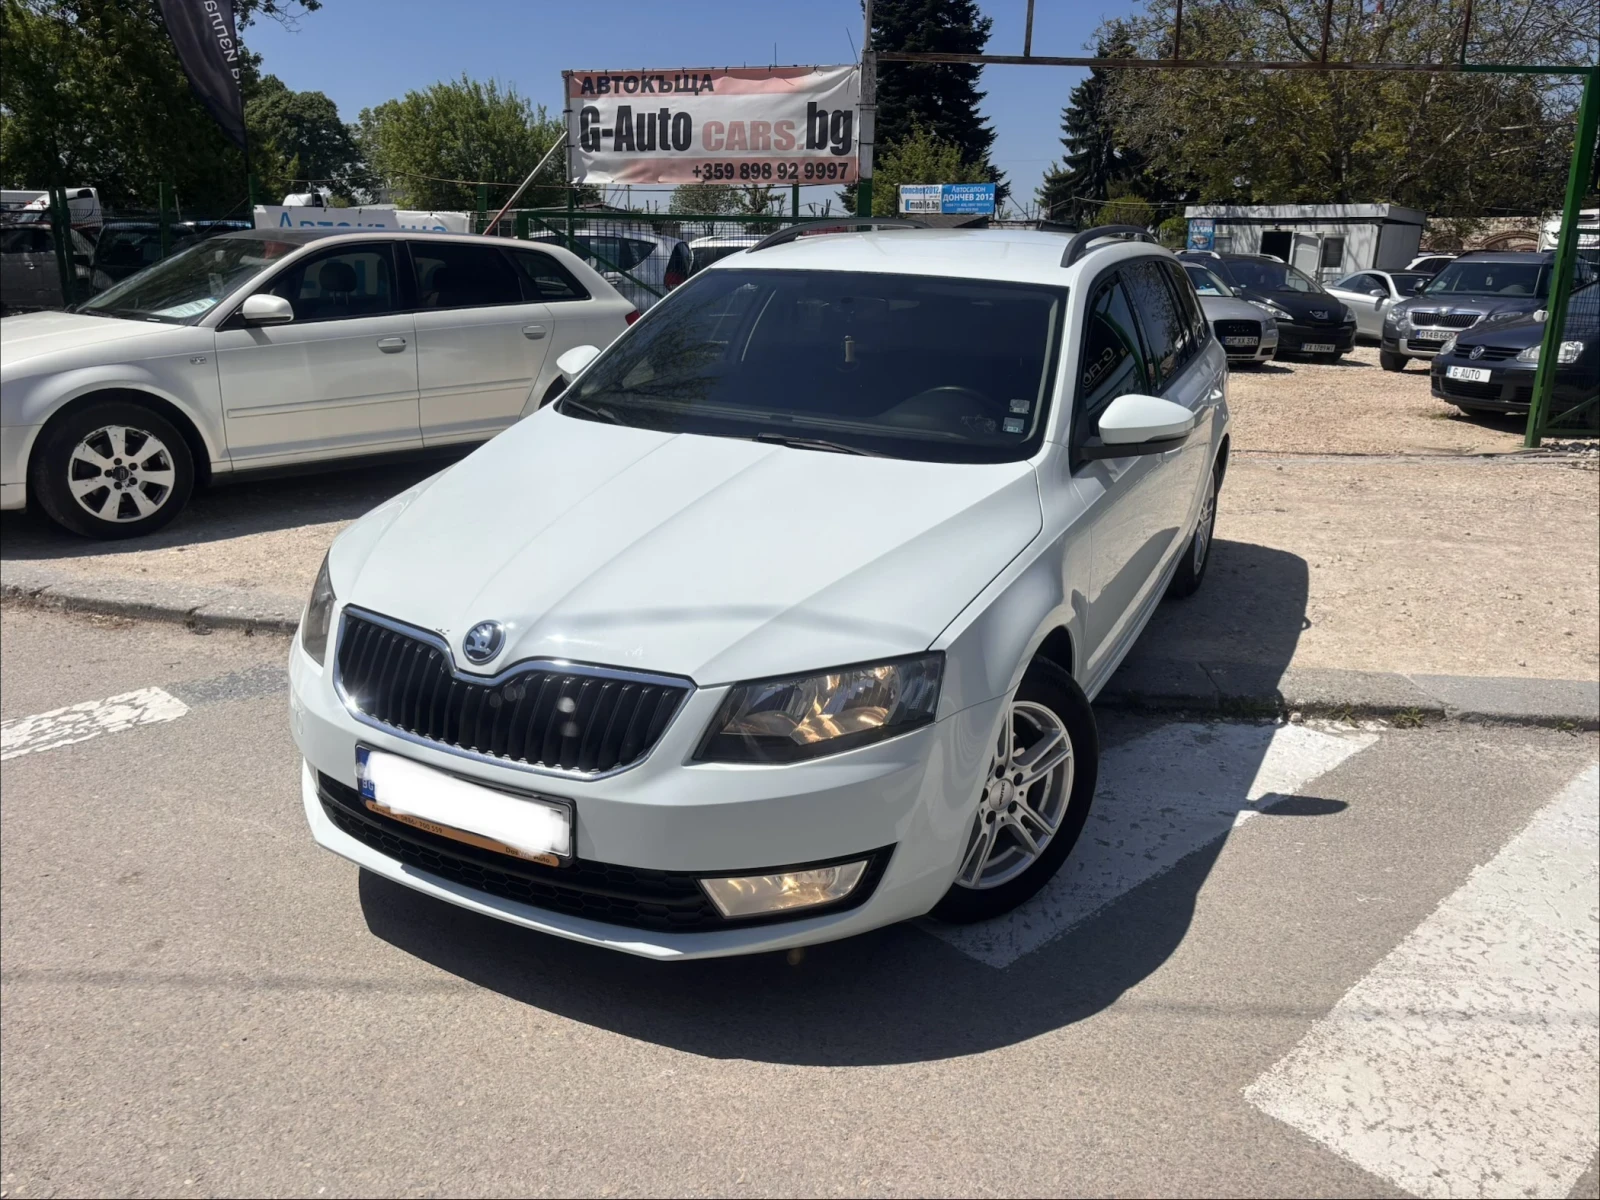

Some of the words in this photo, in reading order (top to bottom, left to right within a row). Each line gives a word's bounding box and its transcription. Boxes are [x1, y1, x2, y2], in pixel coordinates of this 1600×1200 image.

[581, 75, 714, 95] АВТОКЪЩА
[579, 105, 692, 152] G-Auto
[692, 164, 735, 180] +359
[739, 163, 772, 180] 898
[779, 163, 799, 180] 92
[804, 162, 849, 179] 9997
[943, 194, 974, 202] ДОНЧЕВ
[975, 193, 994, 201] 2012
